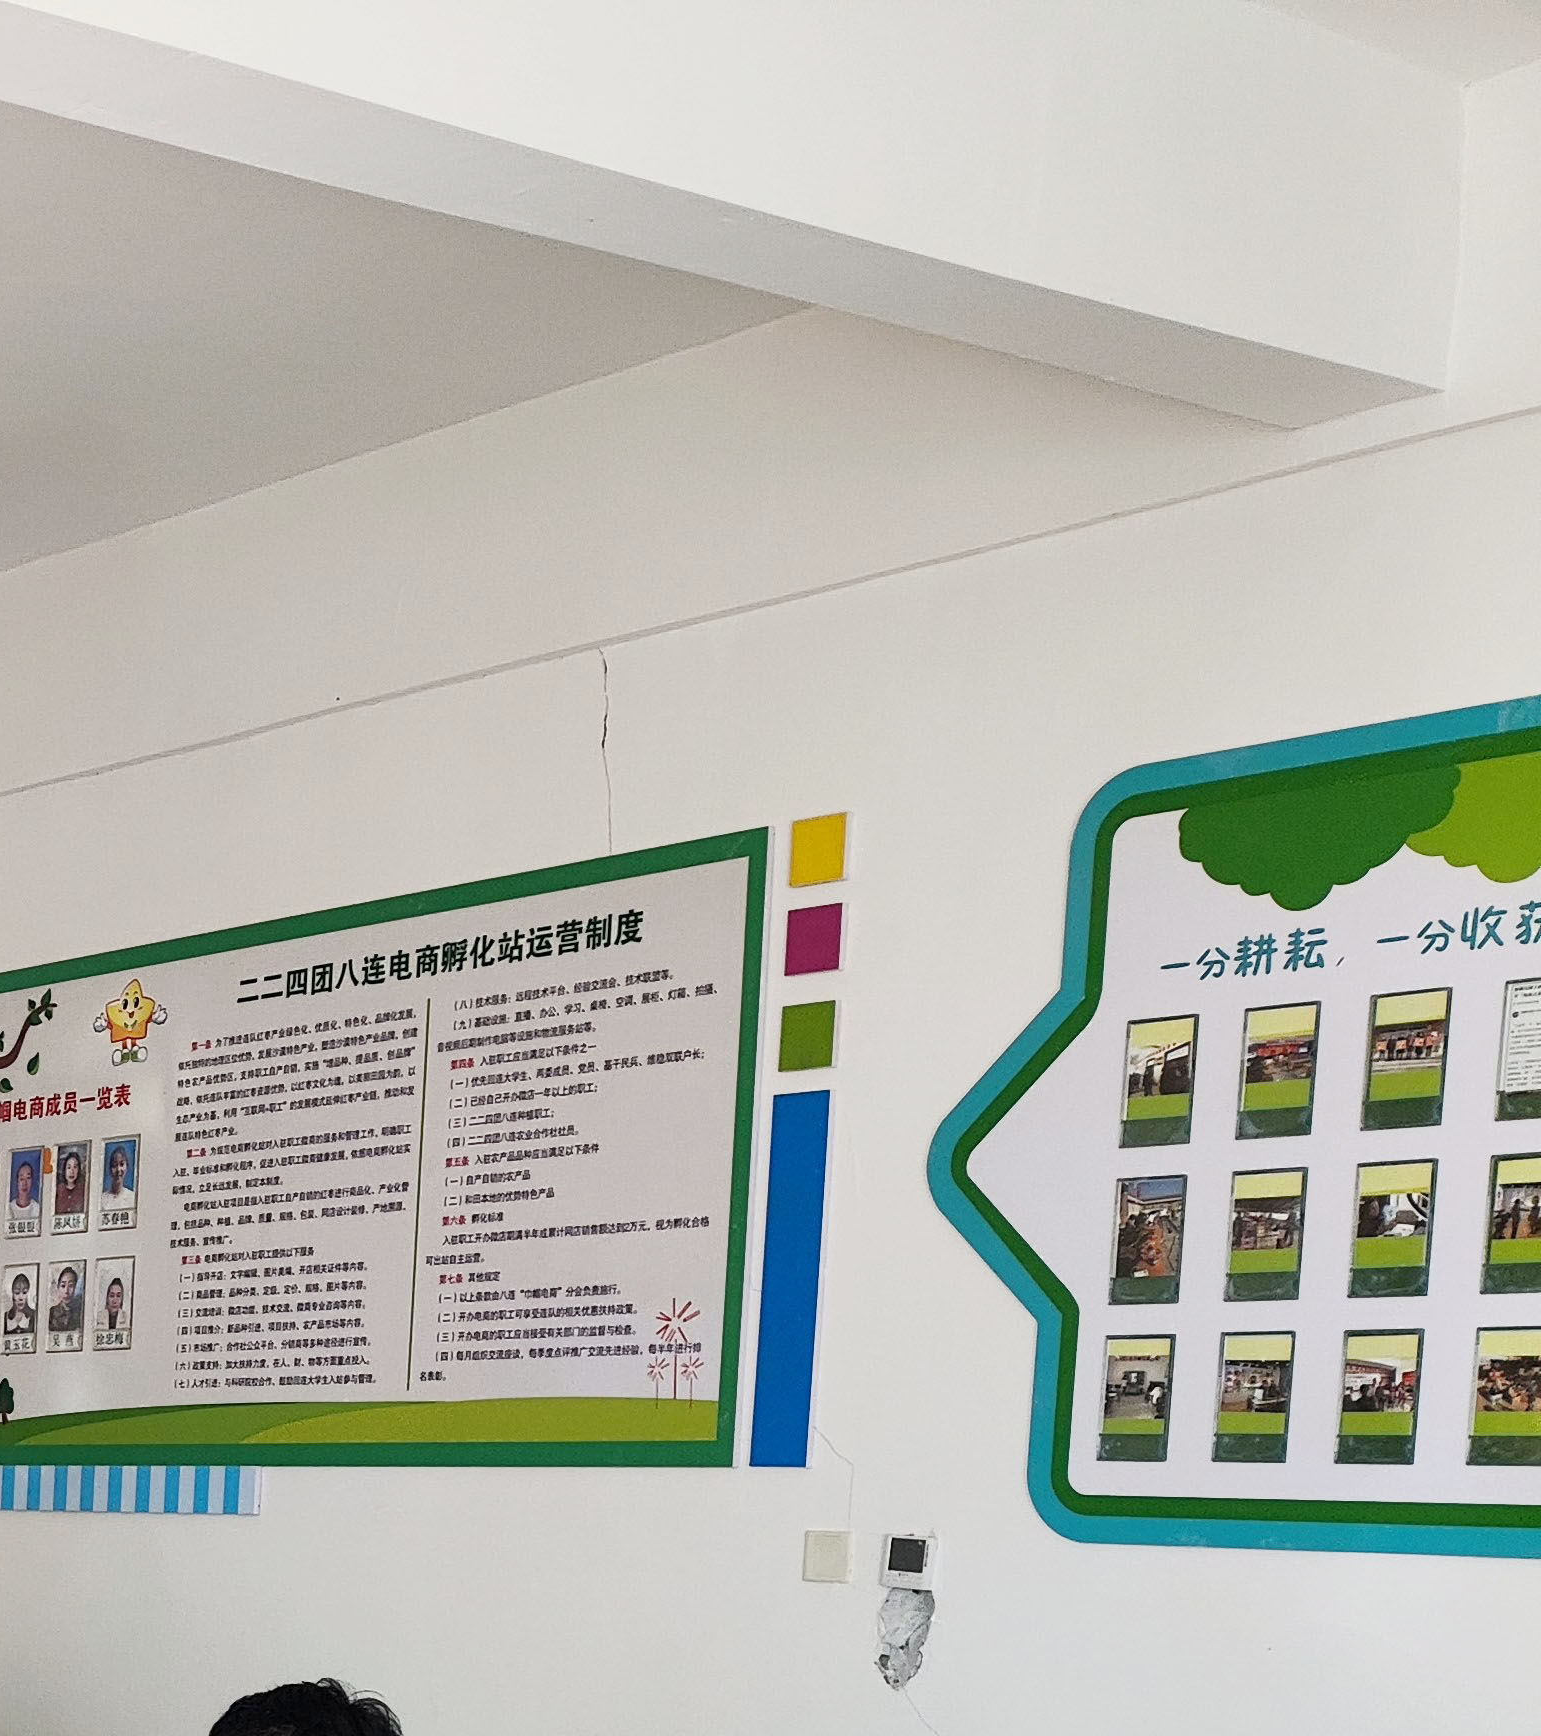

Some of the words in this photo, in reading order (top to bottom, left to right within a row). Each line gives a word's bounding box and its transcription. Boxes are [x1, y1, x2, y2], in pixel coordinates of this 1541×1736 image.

[236, 908, 644, 1004] 二二四团八连电商孵化站运营制度
